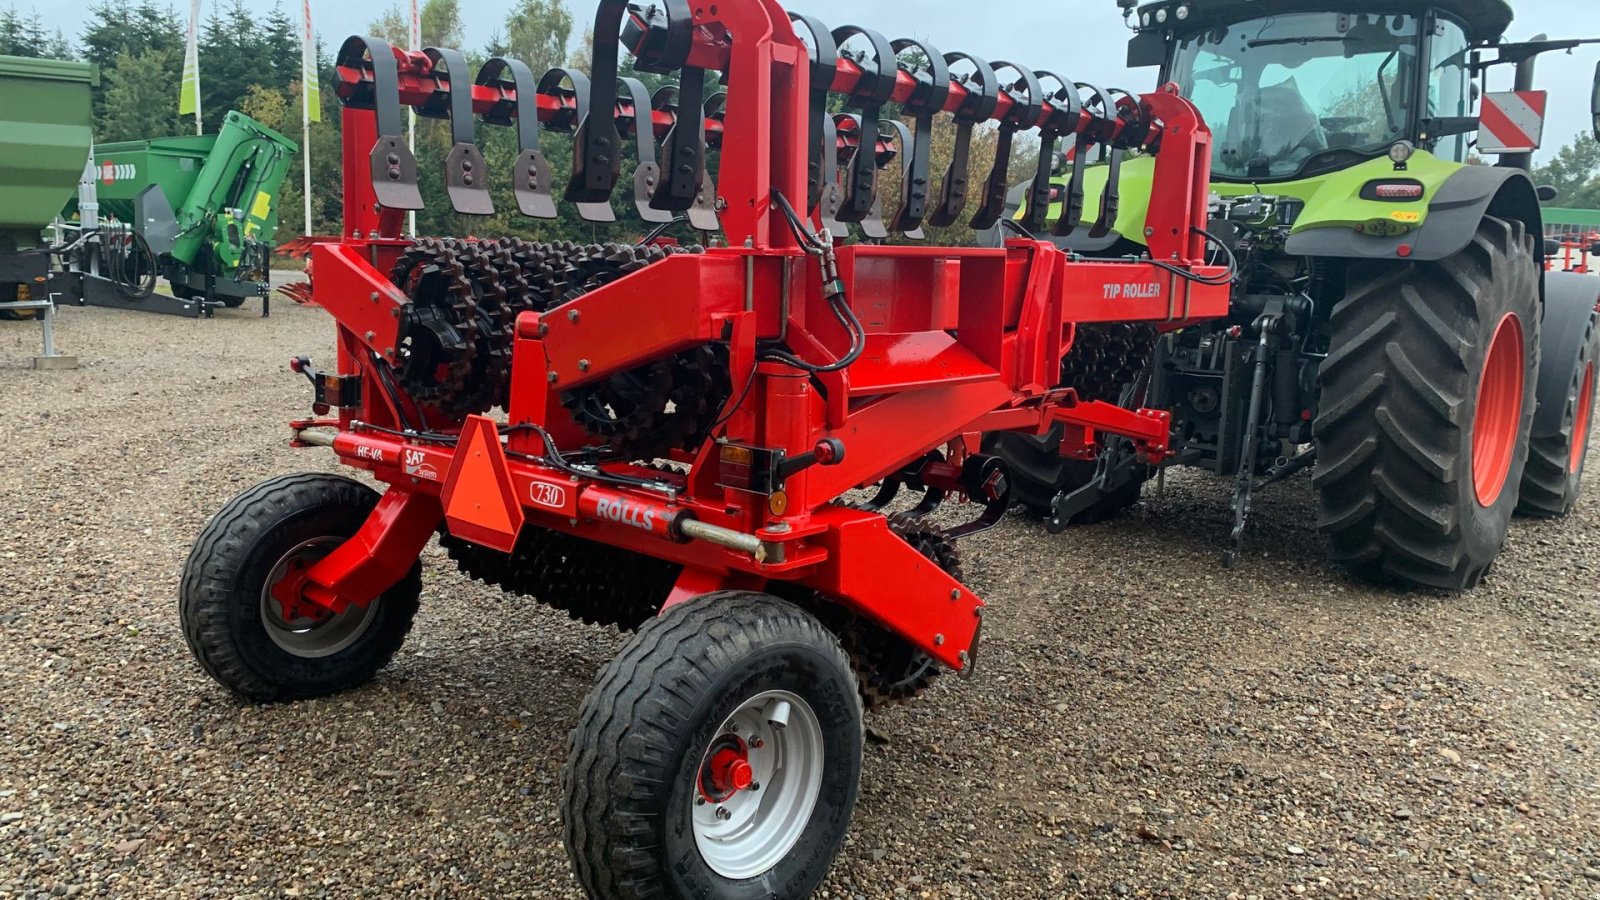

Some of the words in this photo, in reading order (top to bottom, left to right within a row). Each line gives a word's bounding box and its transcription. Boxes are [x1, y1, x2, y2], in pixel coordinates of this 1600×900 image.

[1103, 283, 1121, 299] TIP
[1122, 282, 1161, 299] ROLLER
[405, 449, 425, 466] SAT
[536, 484, 559, 505] 730
[596, 497, 655, 531] ROLLS
